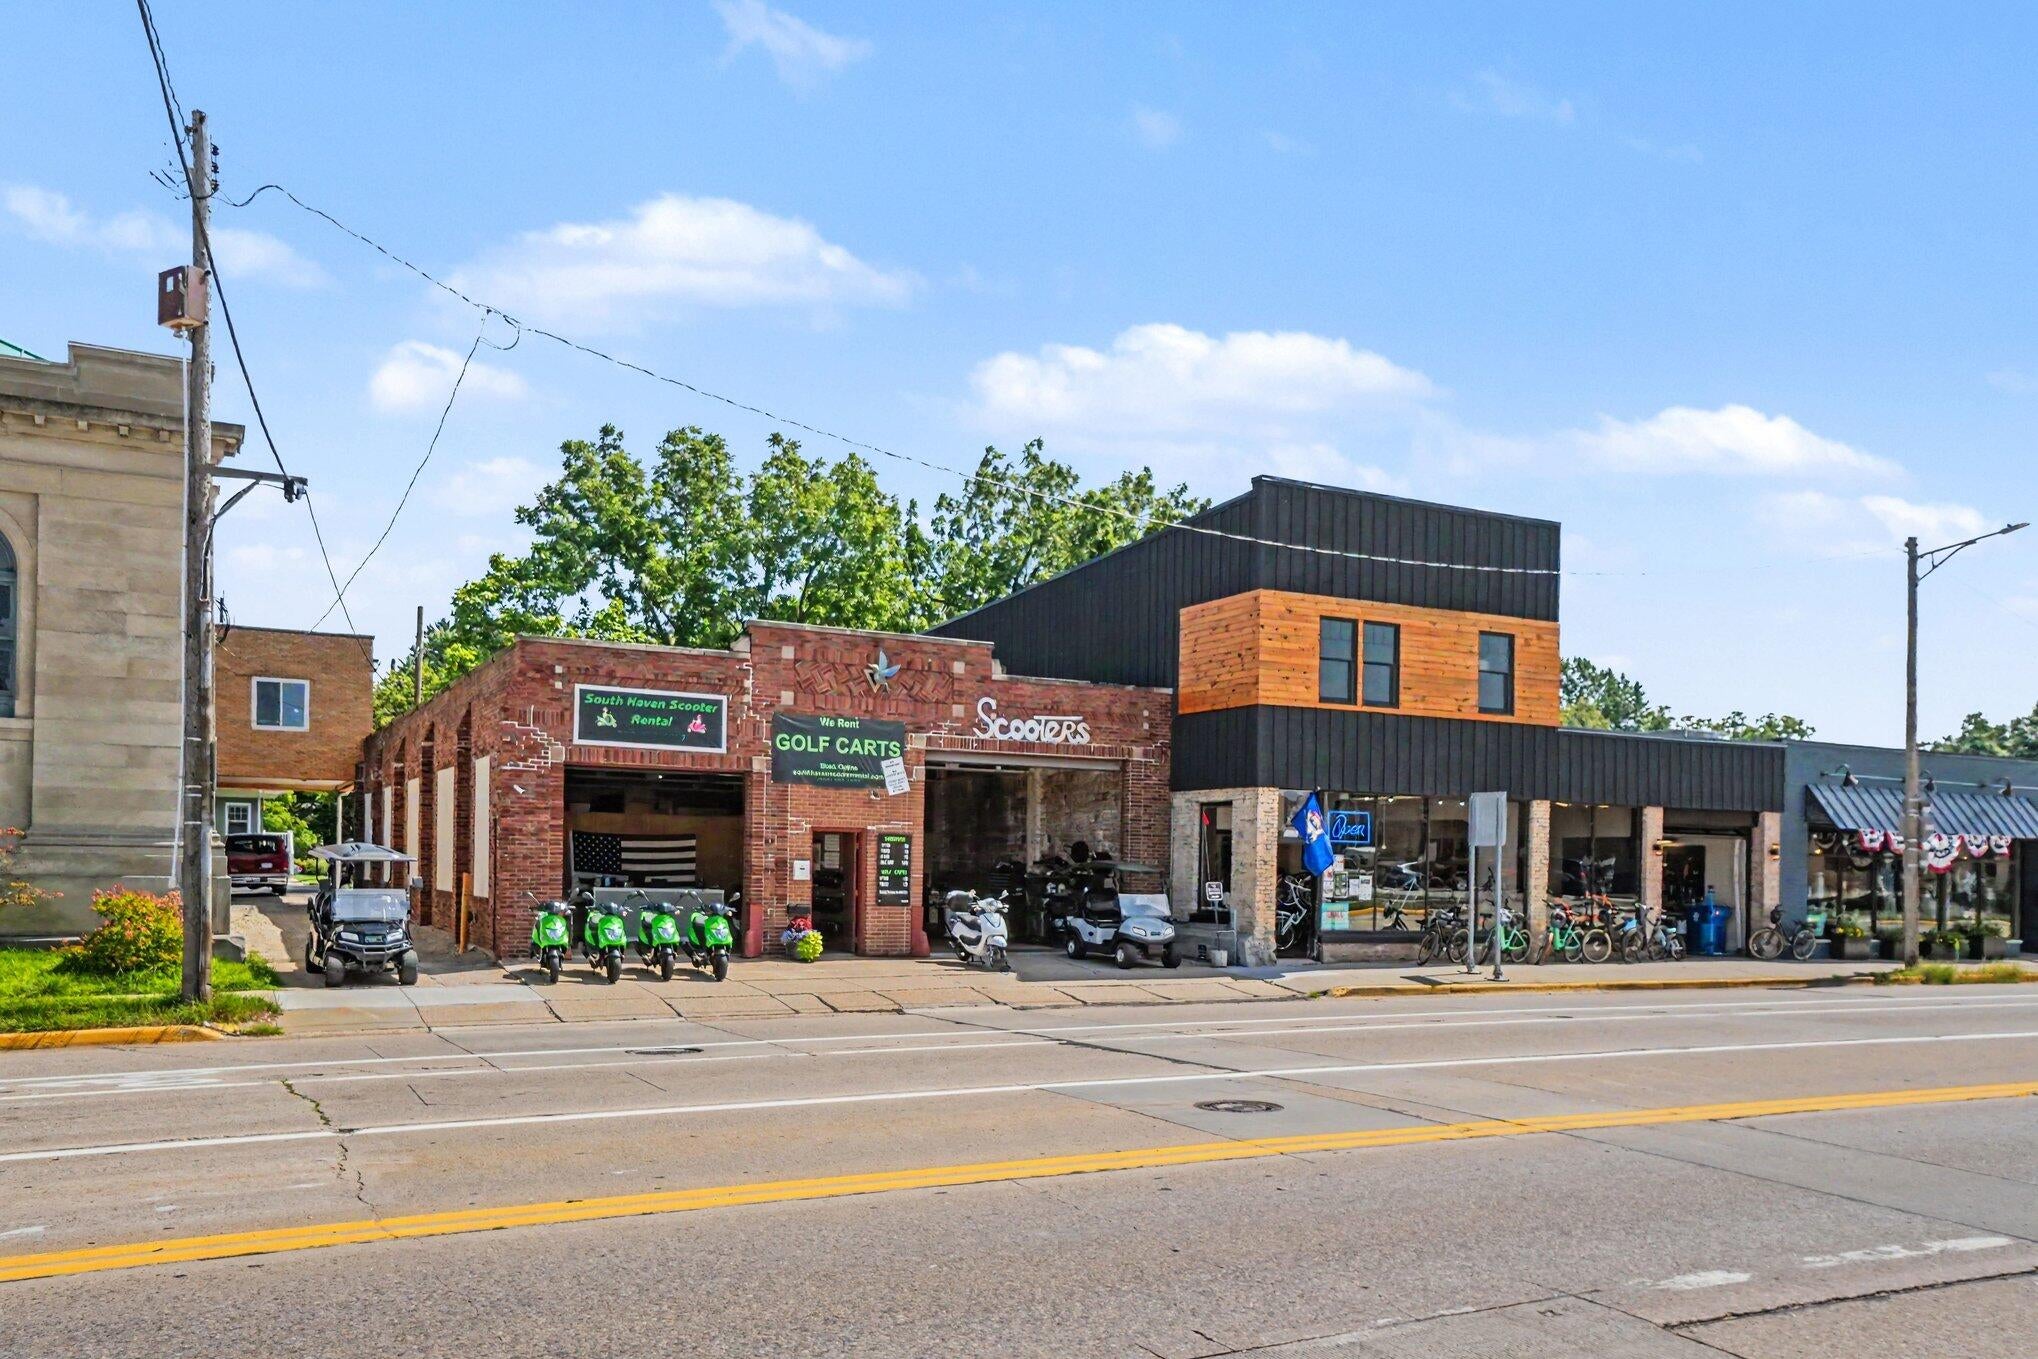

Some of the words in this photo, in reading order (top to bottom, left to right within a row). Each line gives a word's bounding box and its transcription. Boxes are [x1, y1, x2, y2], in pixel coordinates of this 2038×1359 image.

[584, 693, 624, 706] South
[627, 697, 666, 710] Haven
[669, 700, 719, 714] Scooter
[630, 714, 673, 727] Rental
[820, 717, 835, 728] We
[837, 718, 860, 729] Rent
[775, 733, 831, 753] GOLF
[835, 737, 901, 758] CARTS
[1332, 814, 1365, 840] Open
